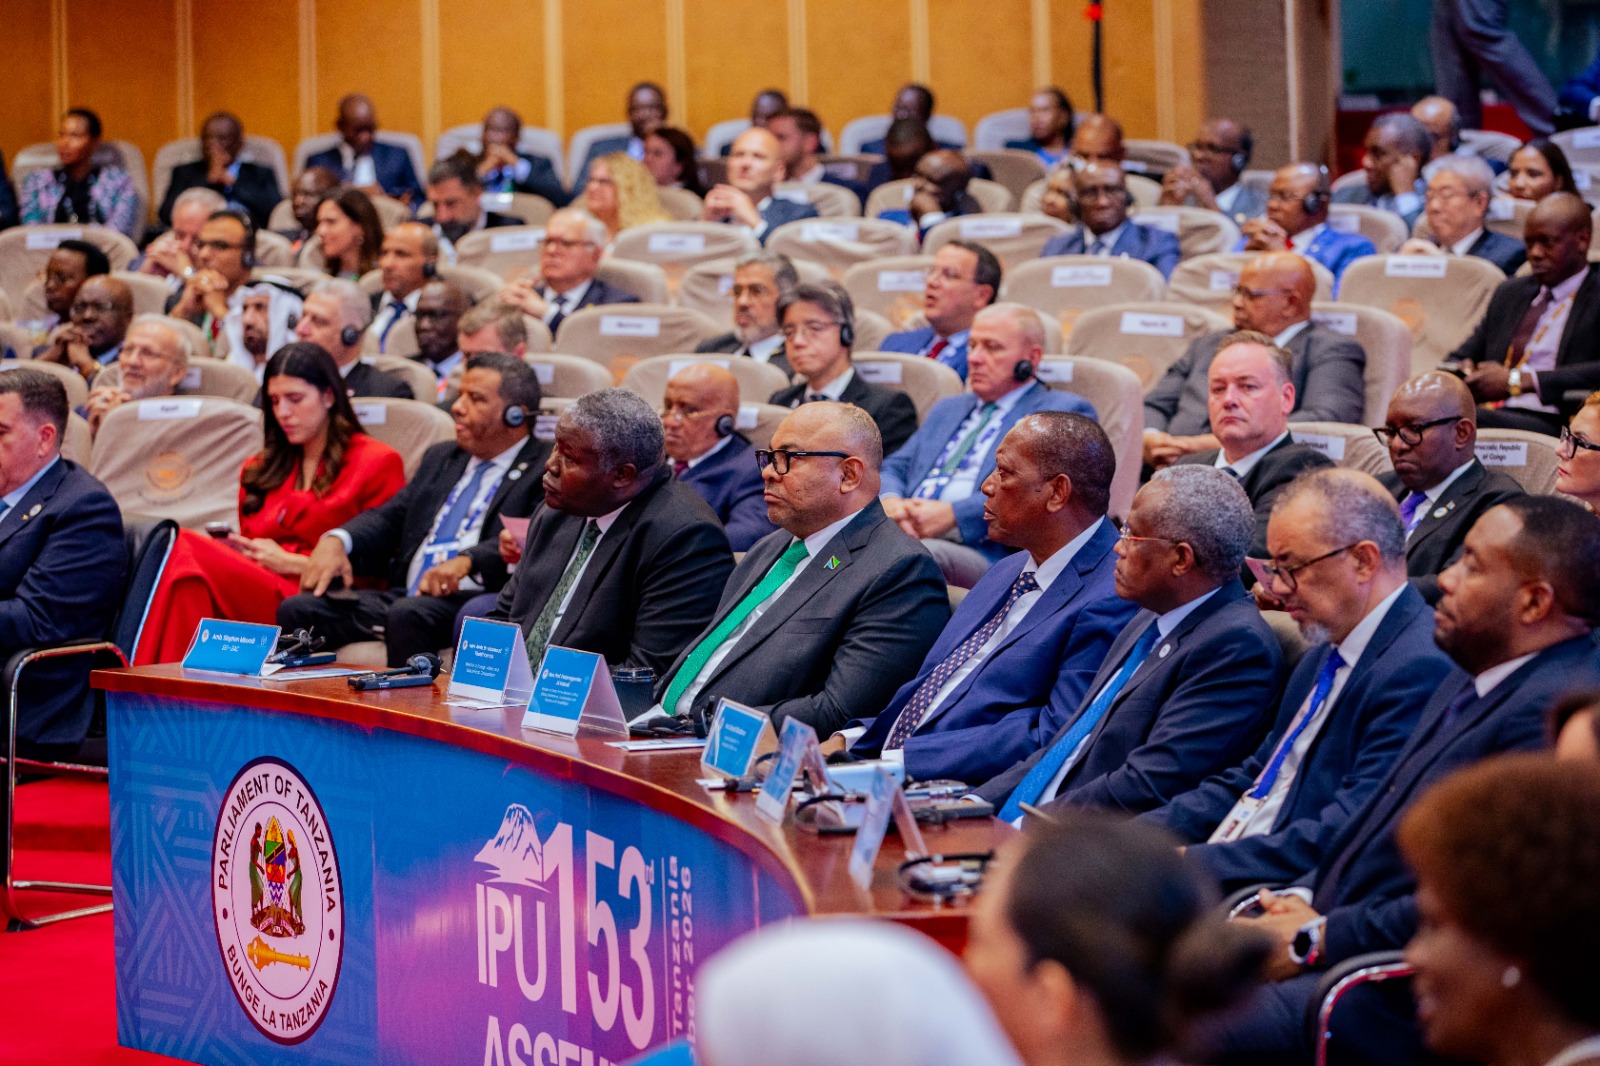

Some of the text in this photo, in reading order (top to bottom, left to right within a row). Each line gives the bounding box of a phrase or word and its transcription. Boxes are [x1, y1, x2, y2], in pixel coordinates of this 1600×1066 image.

[1489, 453, 1507, 461] Congo
[218, 773, 336, 912] PARLIAMENT OF TANZANIA
[476, 883, 547, 1001] IPU
[668, 855, 683, 1036] Tanzania
[680, 866, 694, 966] 2026
[227, 944, 328, 1031] BUNGE LA TANZANIA
